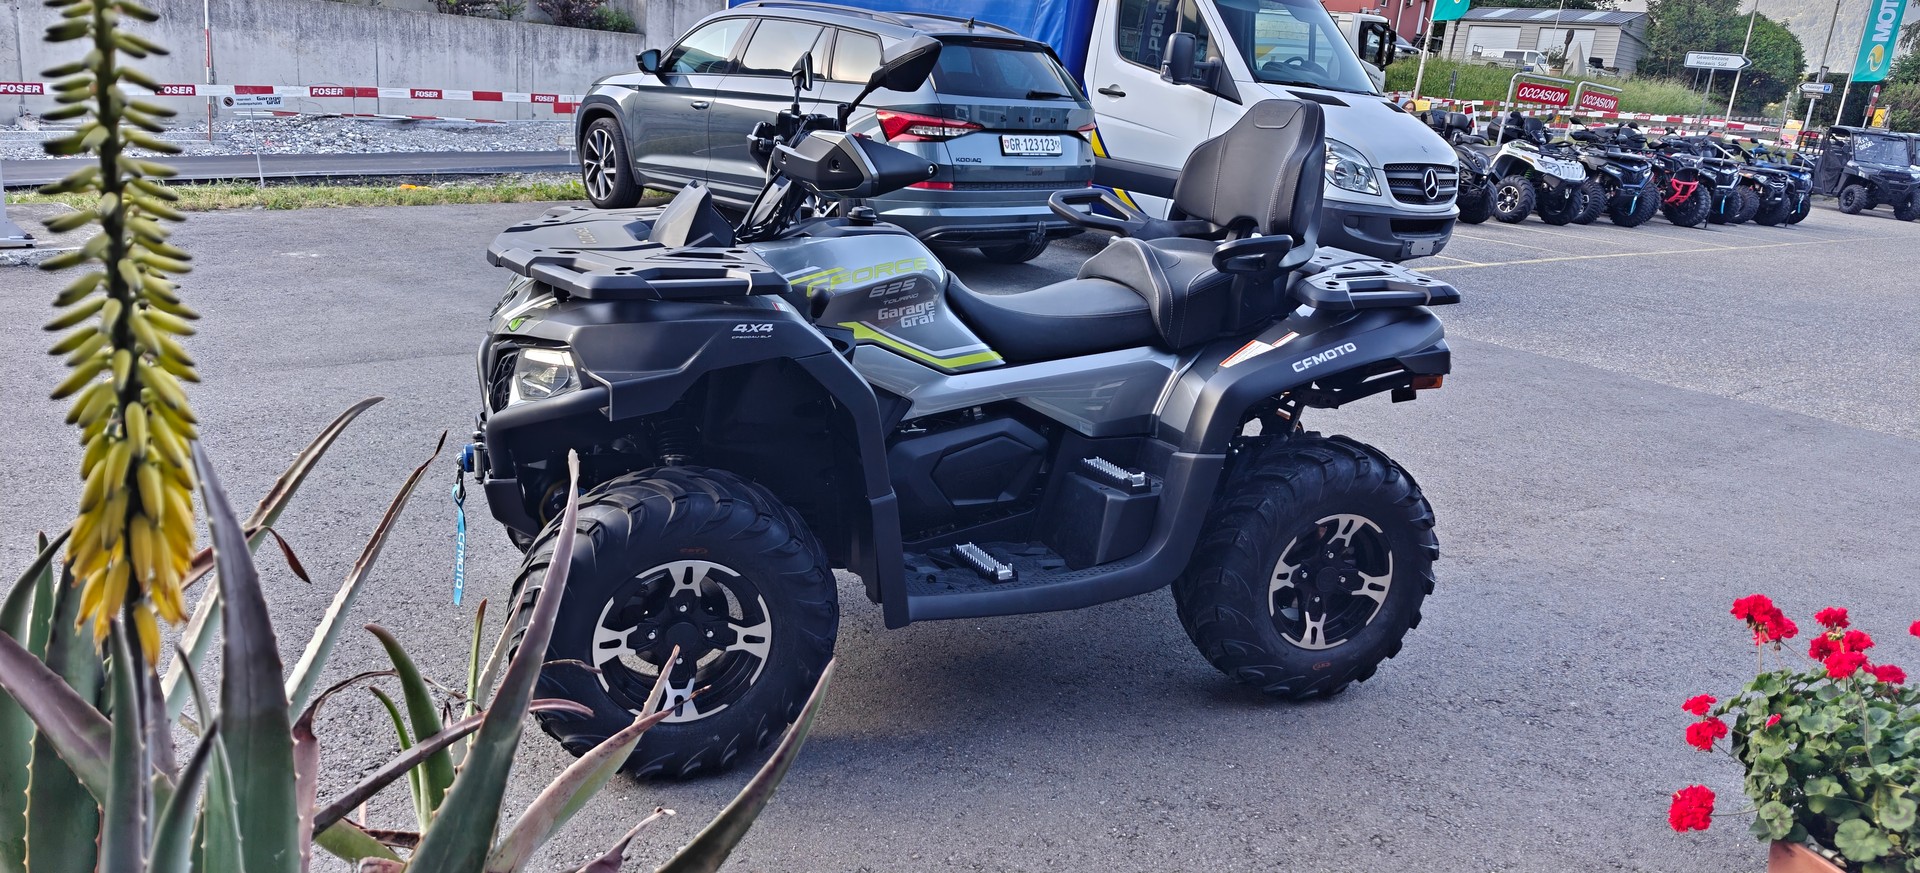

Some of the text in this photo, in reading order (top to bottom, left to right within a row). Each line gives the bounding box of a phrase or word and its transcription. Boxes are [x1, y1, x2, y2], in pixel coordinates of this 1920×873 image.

[0, 84, 41, 93] FOSER
[1519, 86, 1568, 103] OCCASION
[1582, 94, 1617, 109] OCCASION
[869, 278, 917, 299] 625
[883, 292, 920, 305] TOURING
[877, 301, 935, 320] Garage
[900, 310, 936, 328] Graf
[1292, 342, 1357, 373] CFMOTO
[456, 532, 465, 590] CFMOTO
